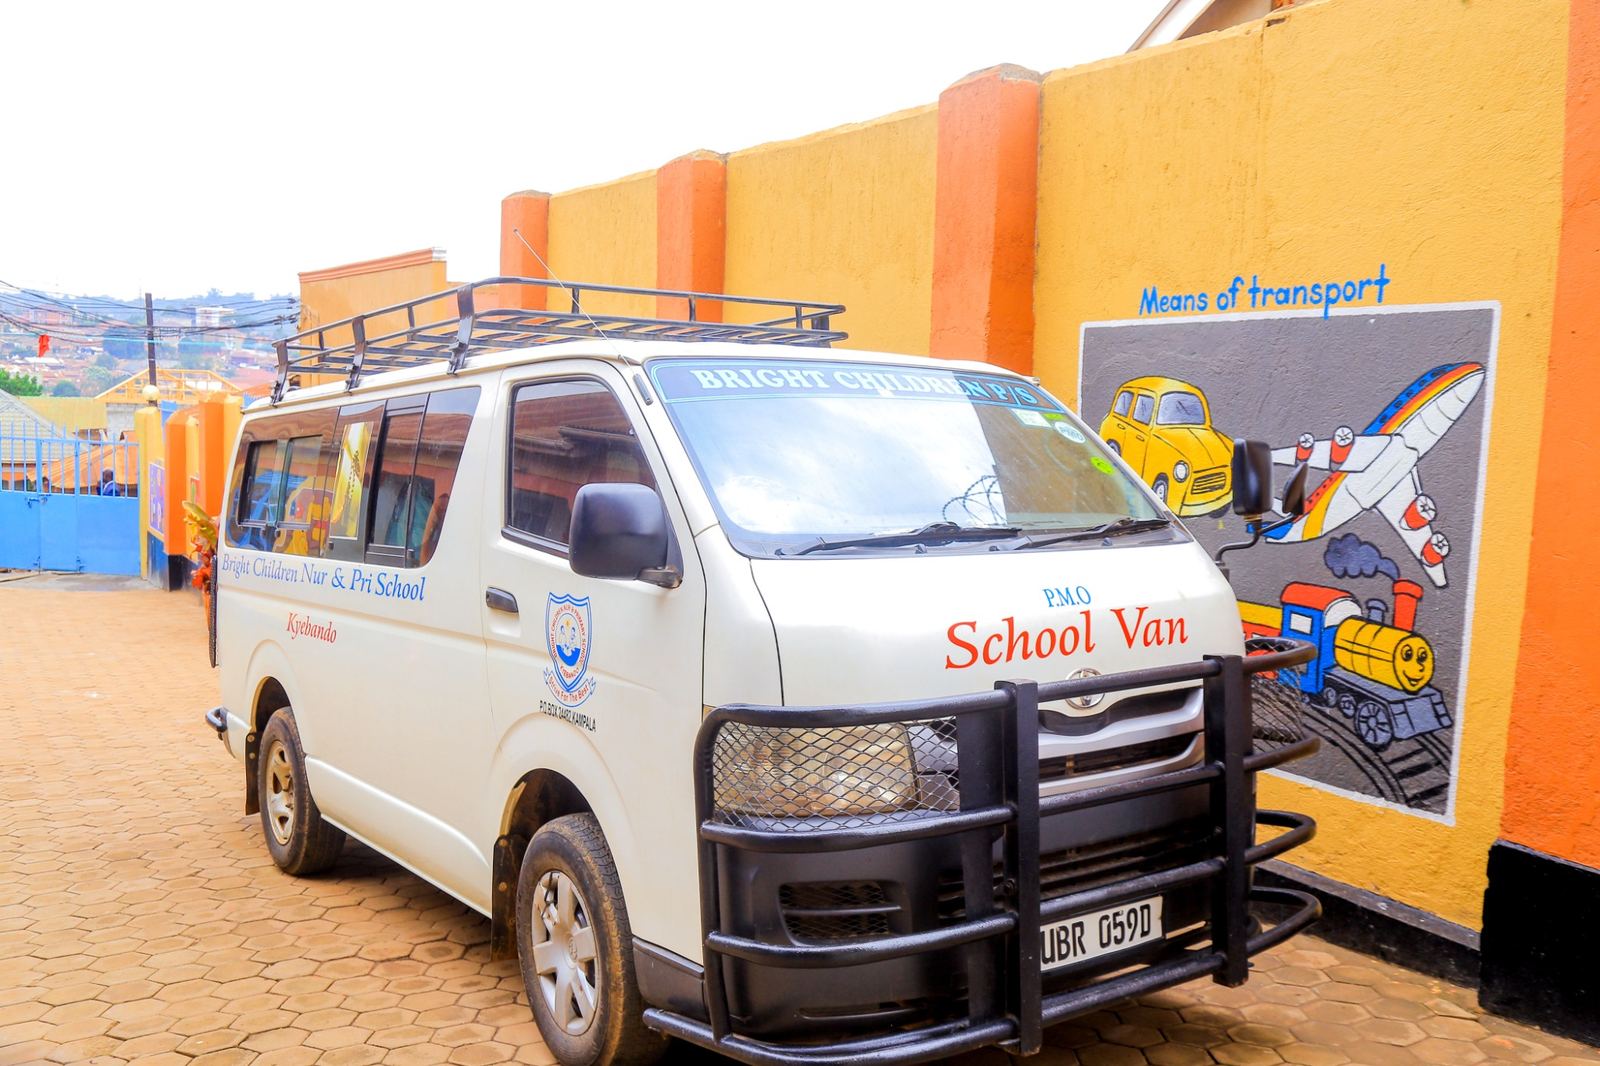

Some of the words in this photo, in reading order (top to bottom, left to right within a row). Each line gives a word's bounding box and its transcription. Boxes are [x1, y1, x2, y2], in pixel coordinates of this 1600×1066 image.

[1139, 285, 1208, 315] Means
[1216, 276, 1245, 311] of
[1248, 263, 1391, 321] transport
[689, 368, 831, 389] BRIGHT
[832, 370, 991, 399] CHILDREN
[986, 382, 1039, 407] P/S
[222, 553, 250, 579] Bright
[253, 557, 298, 582] Children
[301, 562, 328, 585] Nur
[331, 567, 346, 589] &
[349, 568, 373, 593] Pri
[375, 572, 426, 601] School
[1042, 585, 1092, 608] P.M.O
[286, 612, 337, 644] Kyebando
[945, 609, 1096, 670] School
[1110, 605, 1189, 649] Van
[1040, 920, 1086, 965] UBR
[1098, 903, 1151, 949] 059D
